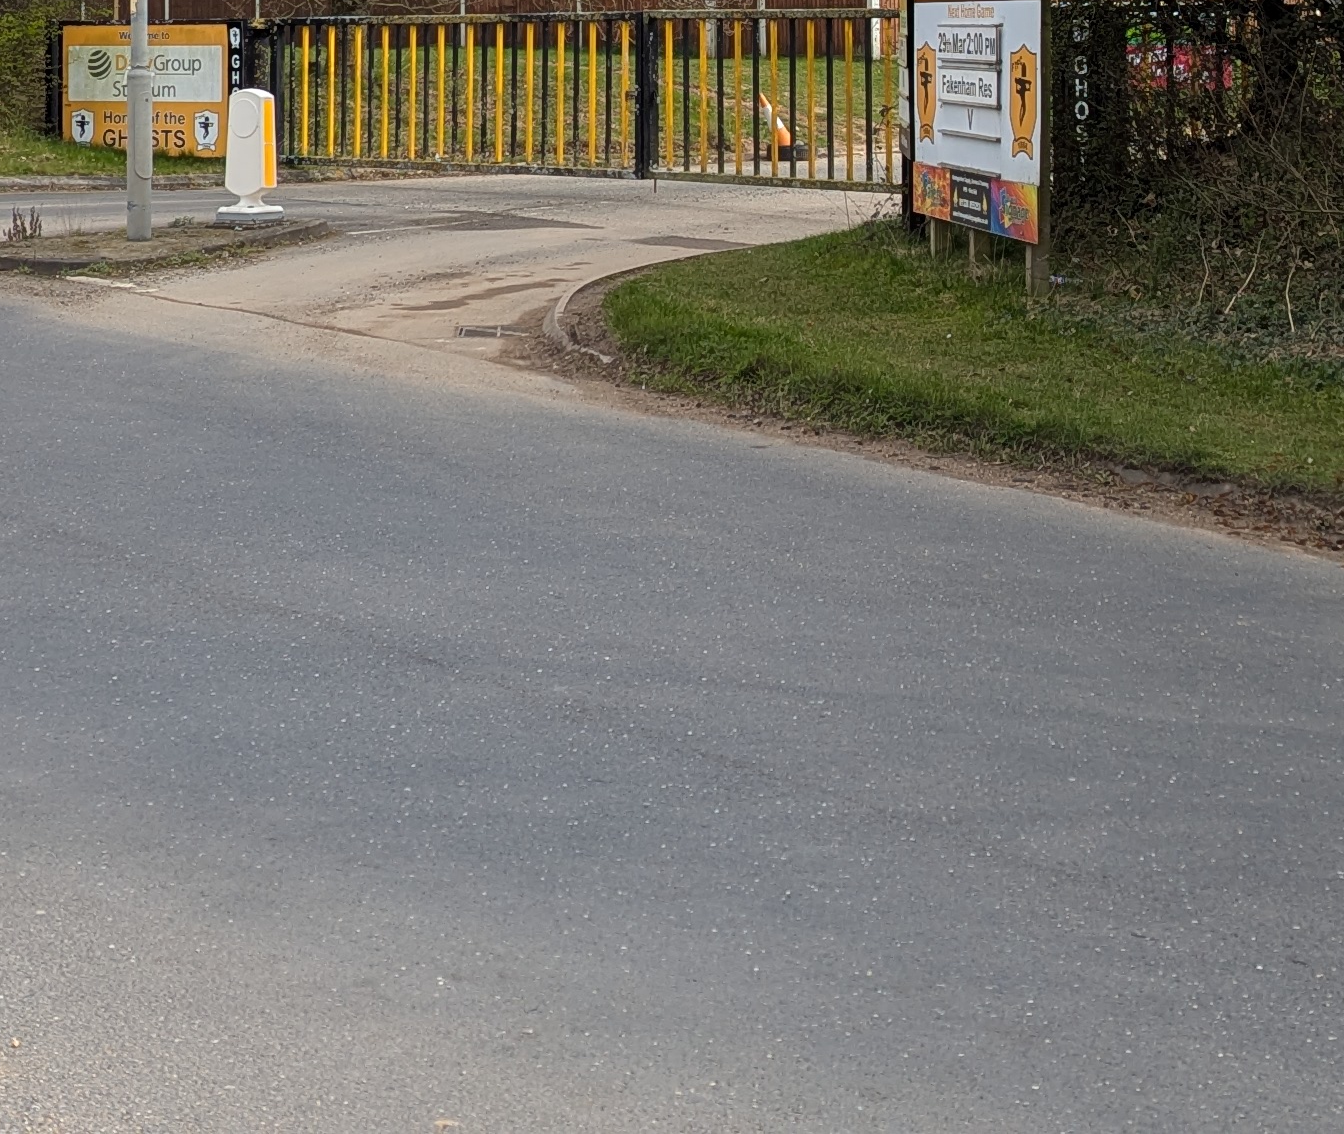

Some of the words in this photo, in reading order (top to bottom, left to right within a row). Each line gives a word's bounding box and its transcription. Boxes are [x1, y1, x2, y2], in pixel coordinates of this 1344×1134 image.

[976, 3, 994, 18] Game
[161, 31, 170, 39] to
[952, 33, 966, 54] Mar
[967, 33, 983, 55] 2:00
[985, 37, 995, 56] PM
[112, 81, 176, 97] Stum
[942, 74, 976, 97] Fakenham
[978, 78, 992, 98] Res
[164, 111, 186, 125] the
[967, 108, 974, 130] V
[102, 129, 186, 148] GHSTS
